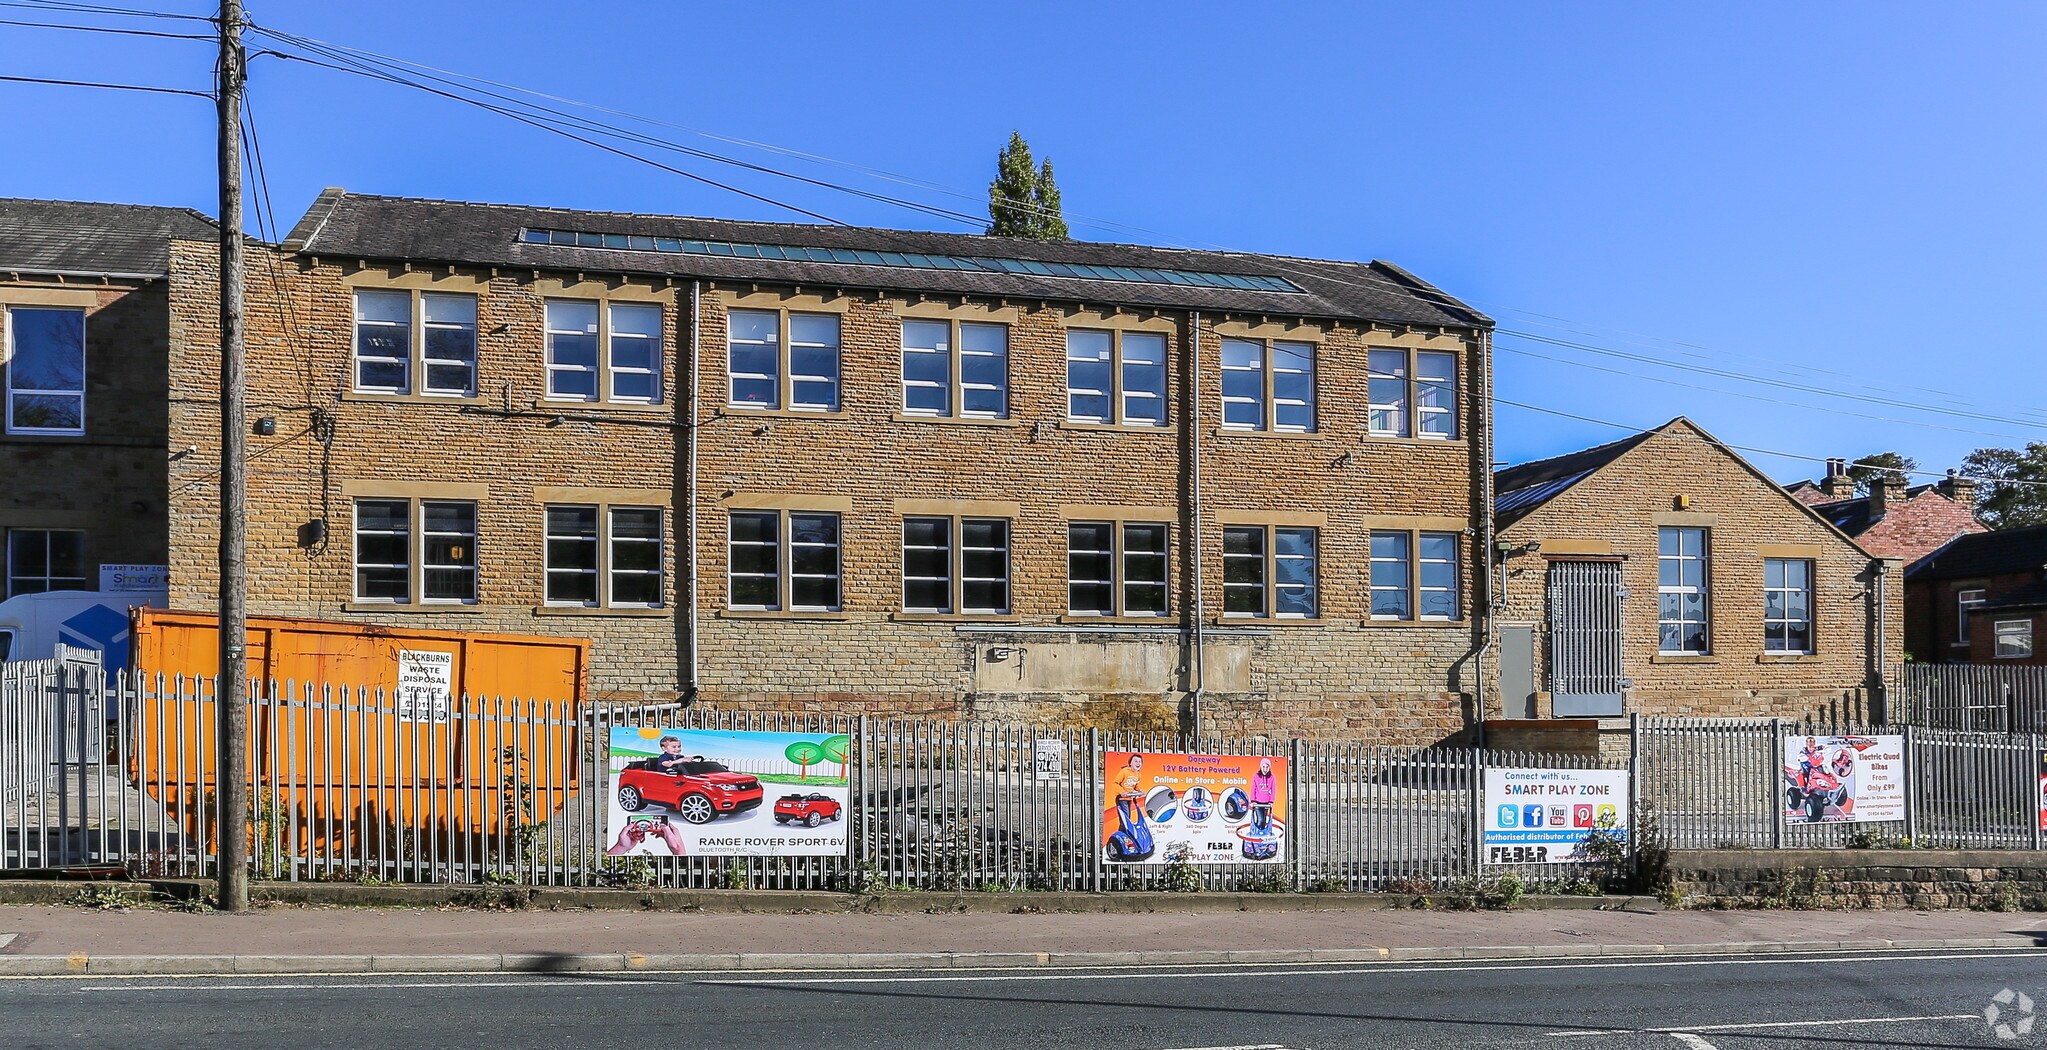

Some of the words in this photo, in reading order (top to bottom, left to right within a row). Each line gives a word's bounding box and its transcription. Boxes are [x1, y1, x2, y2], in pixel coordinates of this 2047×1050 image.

[113, 574, 158, 584] Smart
[402, 653, 450, 663] BLACKBURNS
[410, 666, 440, 674] WASTE
[404, 676, 446, 684] DISPOSAL
[405, 686, 442, 694] SERVICE
[1178, 766, 1206, 774] Battery
[1504, 772, 1538, 780] Connect
[1541, 772, 1558, 780] with
[1561, 773, 1578, 781] us...
[1222, 777, 1247, 785] Mobile
[1504, 784, 1544, 795] SMART
[1549, 785, 1576, 795] PLAY
[1580, 785, 1610, 795] ZONE
[1867, 784, 1881, 792] Only
[1550, 807, 1564, 816] You
[1485, 833, 1525, 841] Authorised
[1527, 832, 1565, 840] distributor
[1567, 832, 1574, 840] of
[699, 837, 741, 846] RANGE
[745, 837, 785, 846] ROVER
[788, 837, 828, 846] SPORT
[830, 837, 845, 846] 6V
[1208, 842, 1233, 850] FEBER
[1213, 853, 1234, 861] ZONE
[1490, 846, 1548, 863] FEBER
